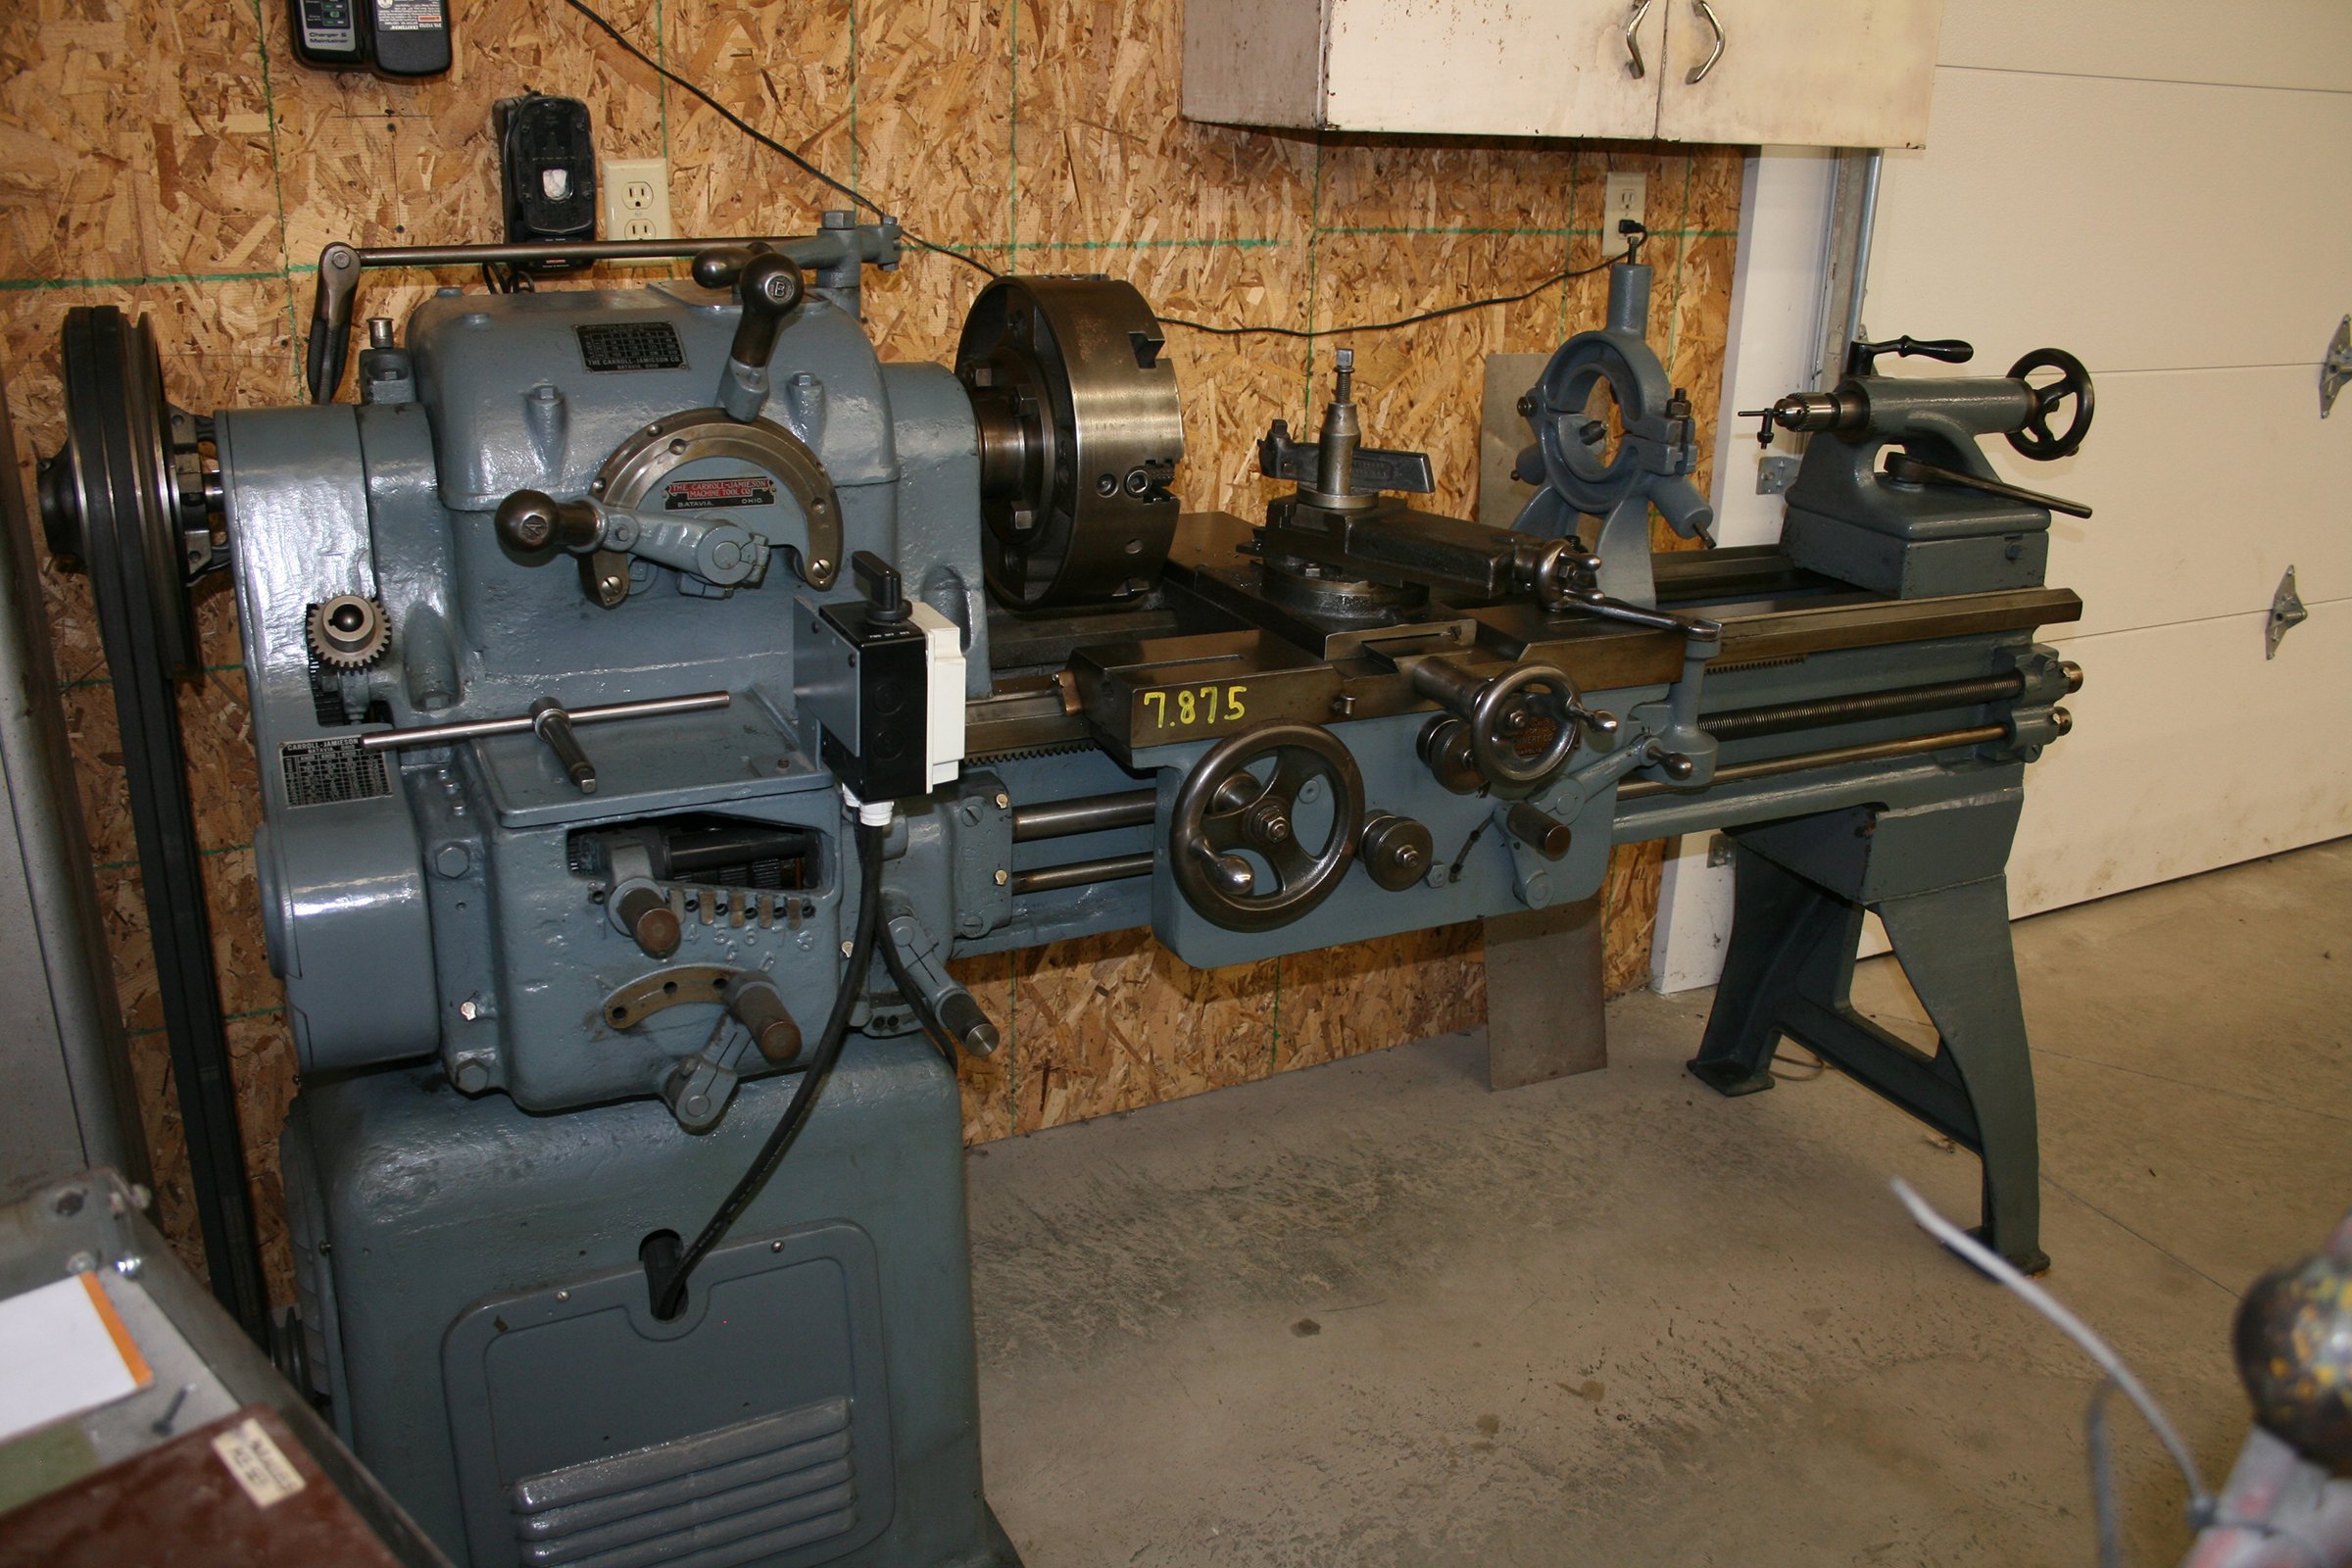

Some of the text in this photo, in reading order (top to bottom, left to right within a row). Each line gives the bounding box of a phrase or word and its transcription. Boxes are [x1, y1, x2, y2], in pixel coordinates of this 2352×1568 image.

[774, 280, 786, 297] B
[691, 479, 766, 491] CARROLL-JAMIESON
[689, 489, 721, 498] MACHINE
[1144, 685, 1248, 729] 7.875
[287, 739, 359, 751] CARROLL-JAMIESON
